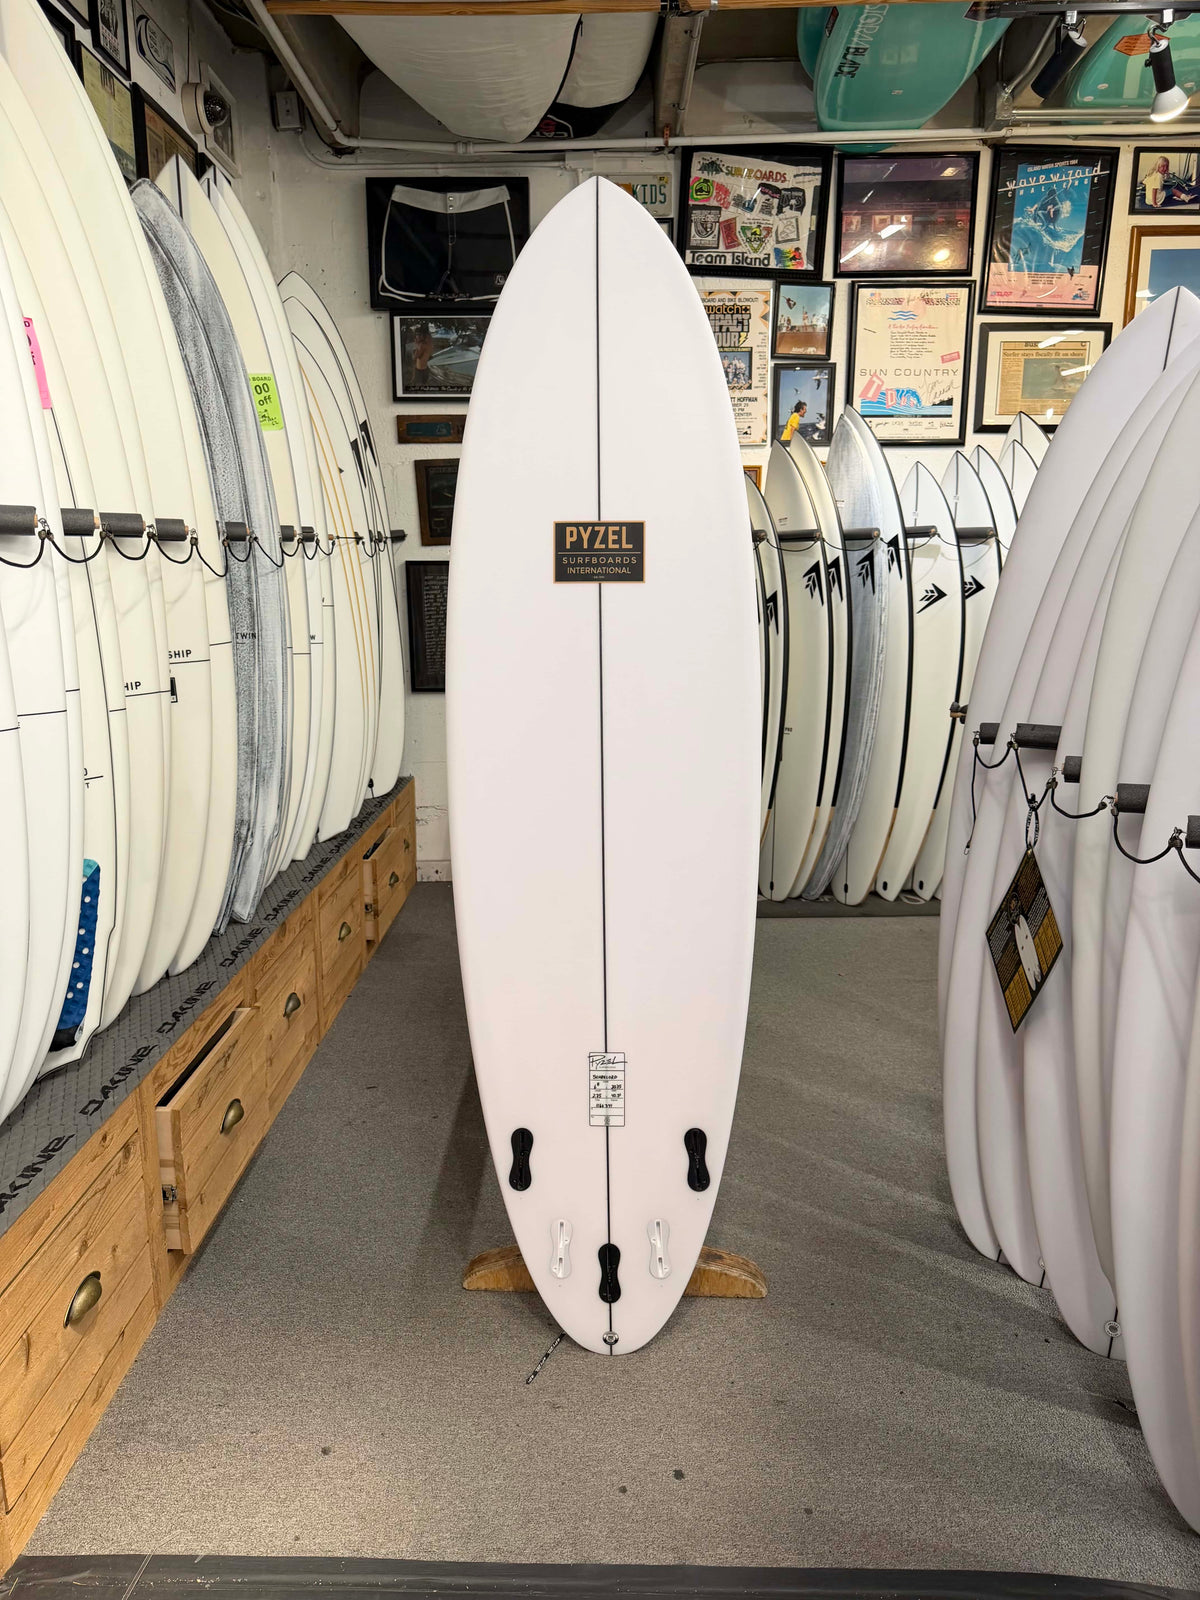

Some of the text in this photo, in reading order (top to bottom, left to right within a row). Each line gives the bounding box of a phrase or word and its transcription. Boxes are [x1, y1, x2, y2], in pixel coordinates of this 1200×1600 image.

[690, 251, 771, 267] Team Island
[859, 368, 959, 377] SUN COUNTRY
[254, 382, 270, 396] 00
[565, 526, 633, 549] PYZEL
[567, 566, 632, 574] INTERNATIONAL
[264, 888, 302, 922] DAKINE
[219, 926, 267, 968] DAKINE
[156, 980, 218, 1034] DAKINE
[79, 1044, 159, 1117] DAKINE
